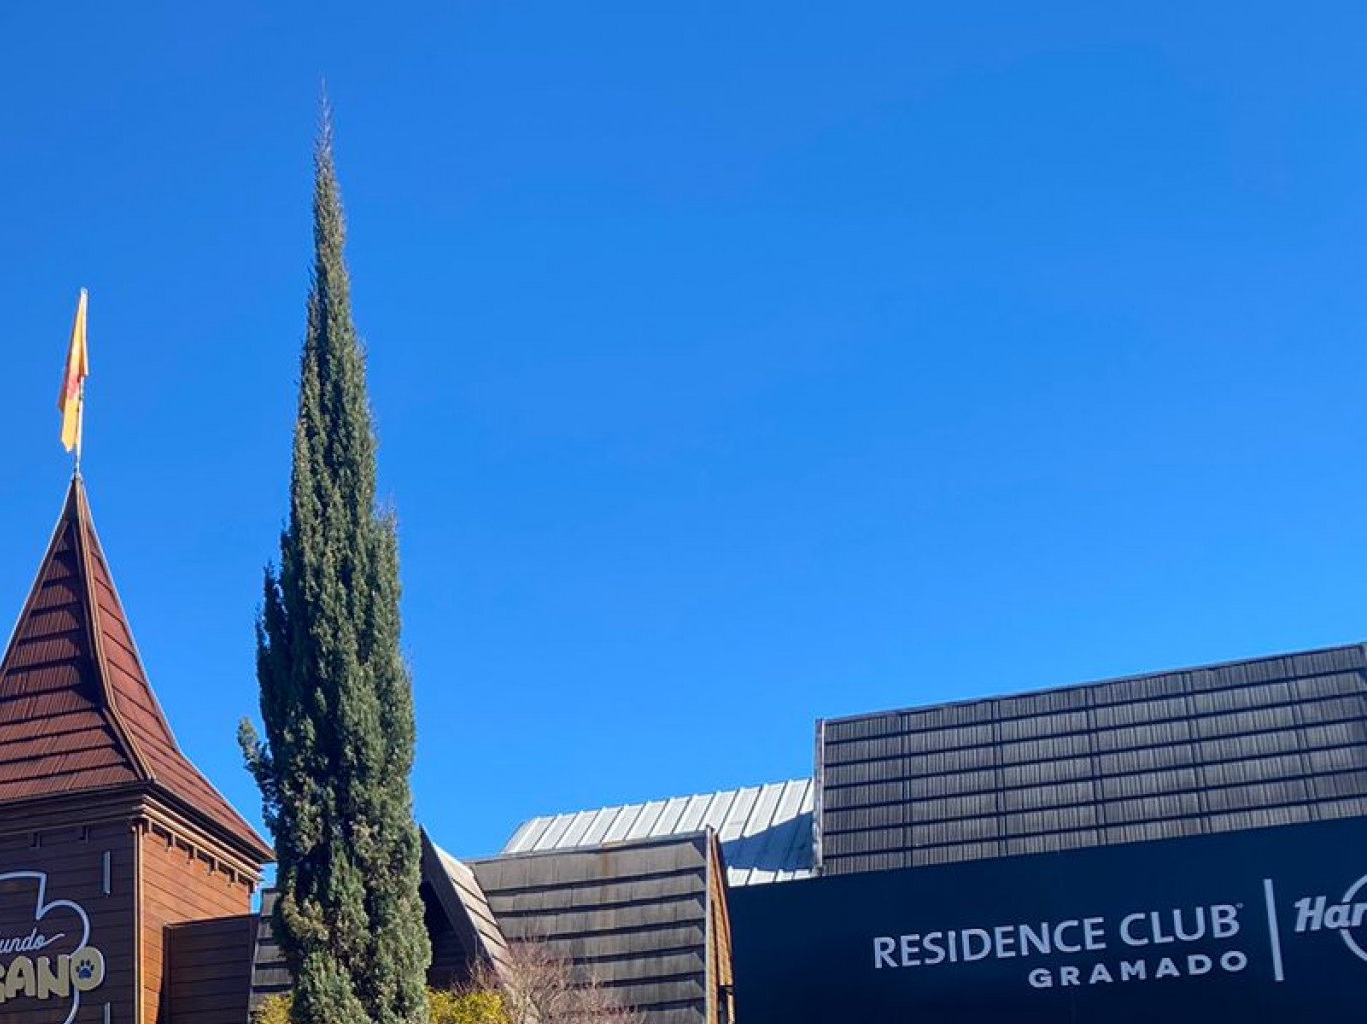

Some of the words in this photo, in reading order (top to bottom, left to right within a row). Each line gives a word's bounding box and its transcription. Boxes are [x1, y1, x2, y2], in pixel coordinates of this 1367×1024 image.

[873, 916, 1107, 969] RESIDENCE
[1120, 904, 1241, 945] CLUB
[1028, 950, 1248, 988] GRAMADO
